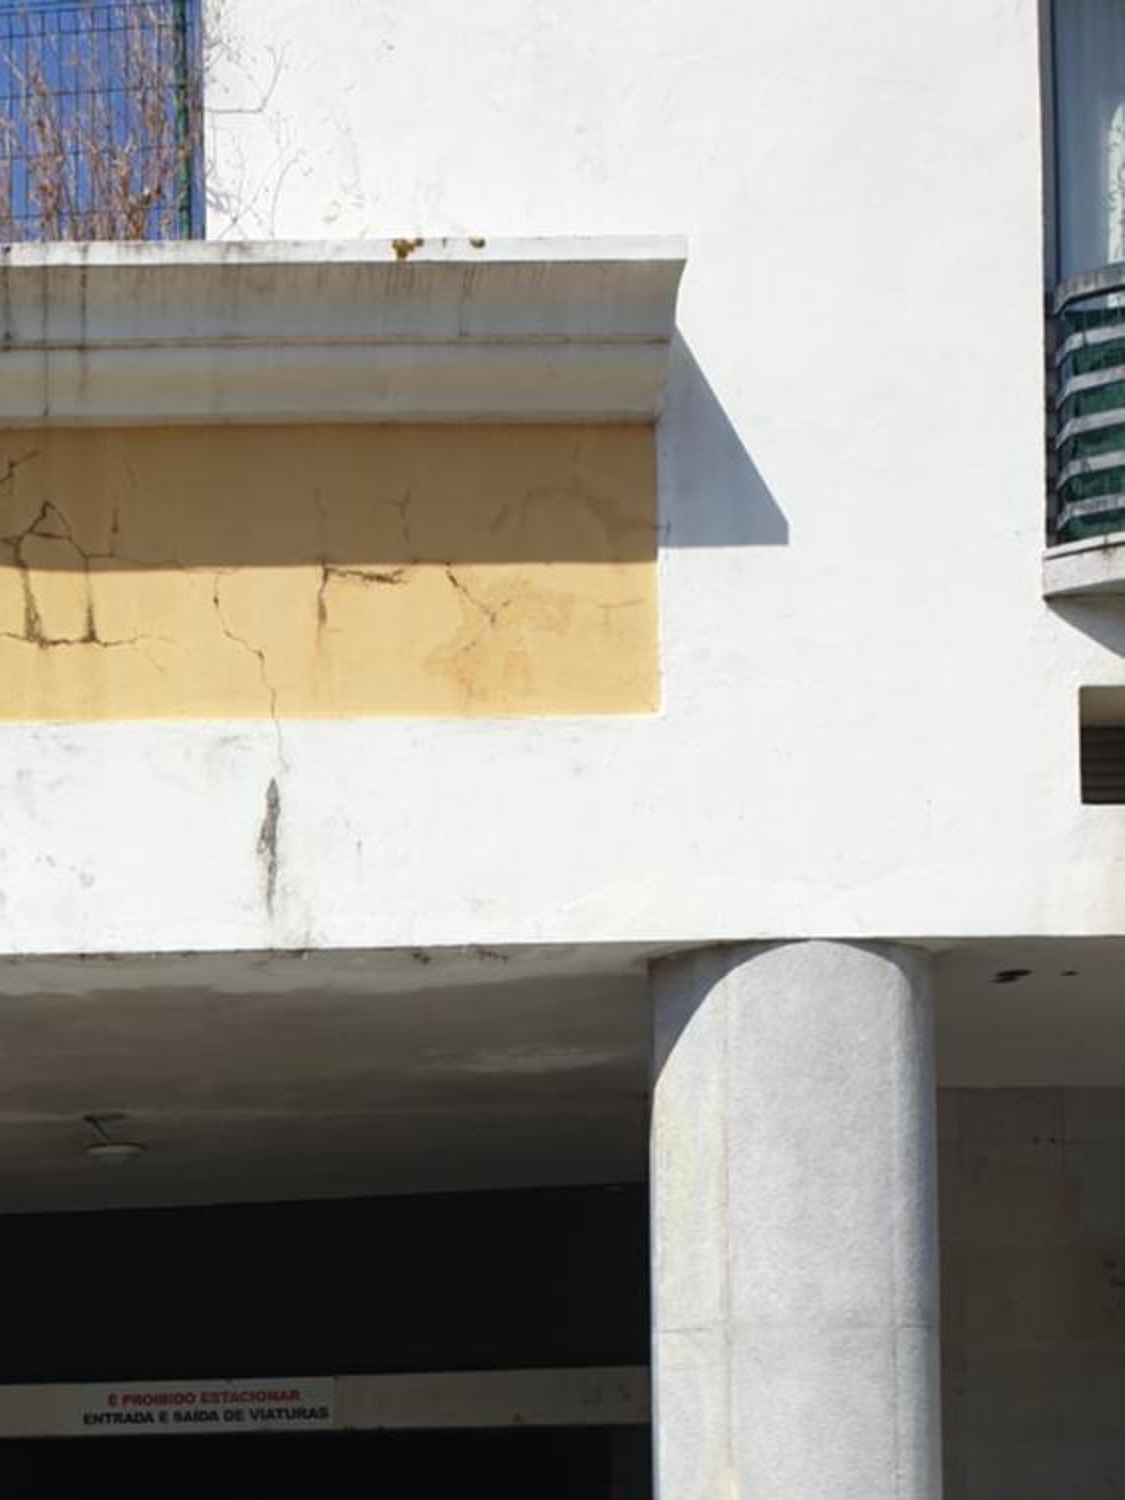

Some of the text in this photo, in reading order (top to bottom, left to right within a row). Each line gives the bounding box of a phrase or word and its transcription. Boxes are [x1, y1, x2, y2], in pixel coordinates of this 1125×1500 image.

[122, 1392, 196, 1406] PROIBIDO
[200, 1389, 300, 1403] ESTACIONAR
[83, 1411, 154, 1424] ENTRADA
[159, 1411, 169, 1423] E
[223, 1409, 245, 1422] DE
[250, 1407, 329, 1421] VIATURAS
